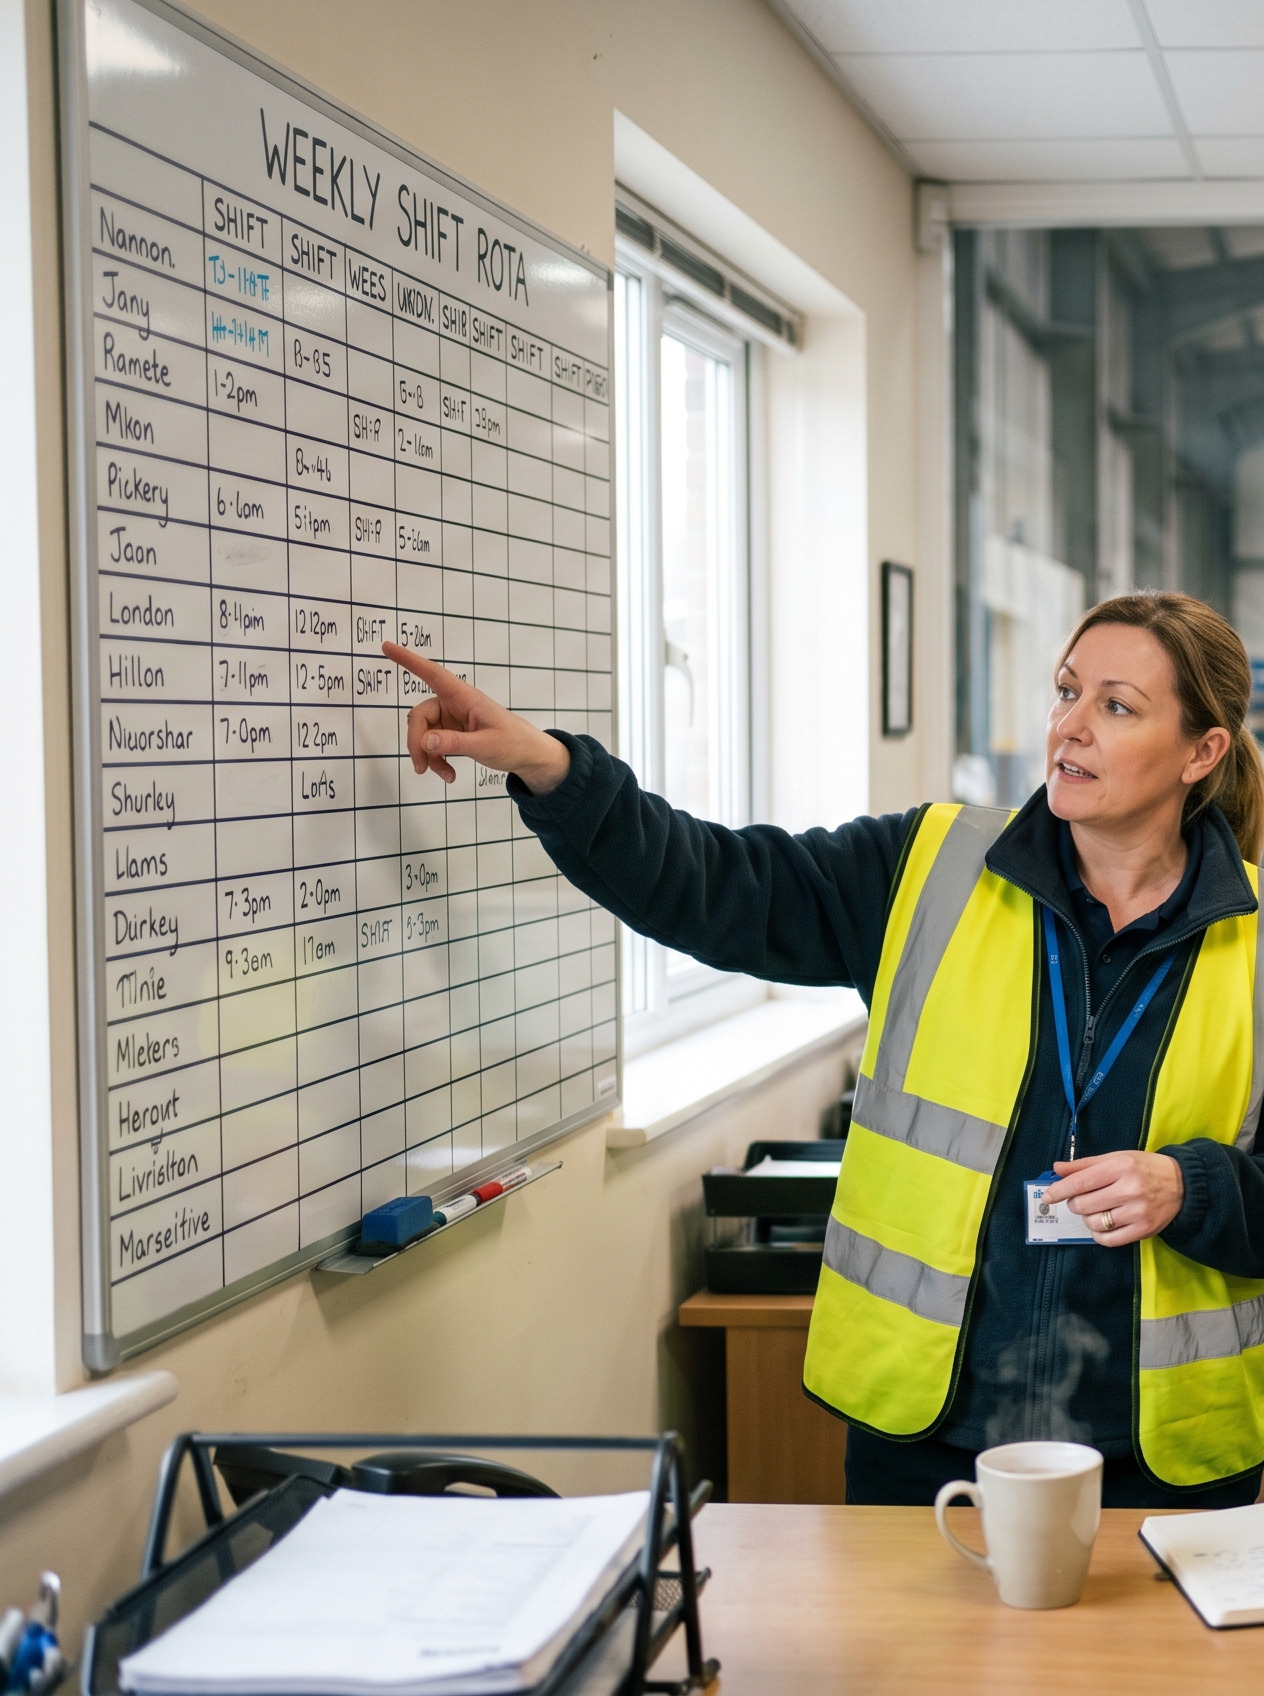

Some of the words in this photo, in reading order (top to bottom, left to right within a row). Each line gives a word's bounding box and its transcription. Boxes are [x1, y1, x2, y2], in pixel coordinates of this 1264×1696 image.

[213, 198, 268, 249] SHIFT
[260, 107, 381, 231] WEEKLY
[397, 184, 464, 272] SHIFT
[477, 227, 530, 307] ROTA
[290, 233, 337, 280] SHIFT
[349, 258, 388, 302] WEES
[102, 271, 150, 341] Jany
[472, 317, 504, 352] SHIFT
[511, 334, 544, 371] SHIFT
[103, 332, 172, 388] Ramete
[554, 356, 582, 388] SHIFT
[214, 369, 258, 412] 1-2pm
[105, 400, 154, 444] Mkon
[107, 461, 168, 528] Pickery
[110, 591, 174, 628] London
[108, 653, 165, 690] Hillon
[111, 780, 176, 831] Shurley
[113, 907, 179, 957] Durkey
